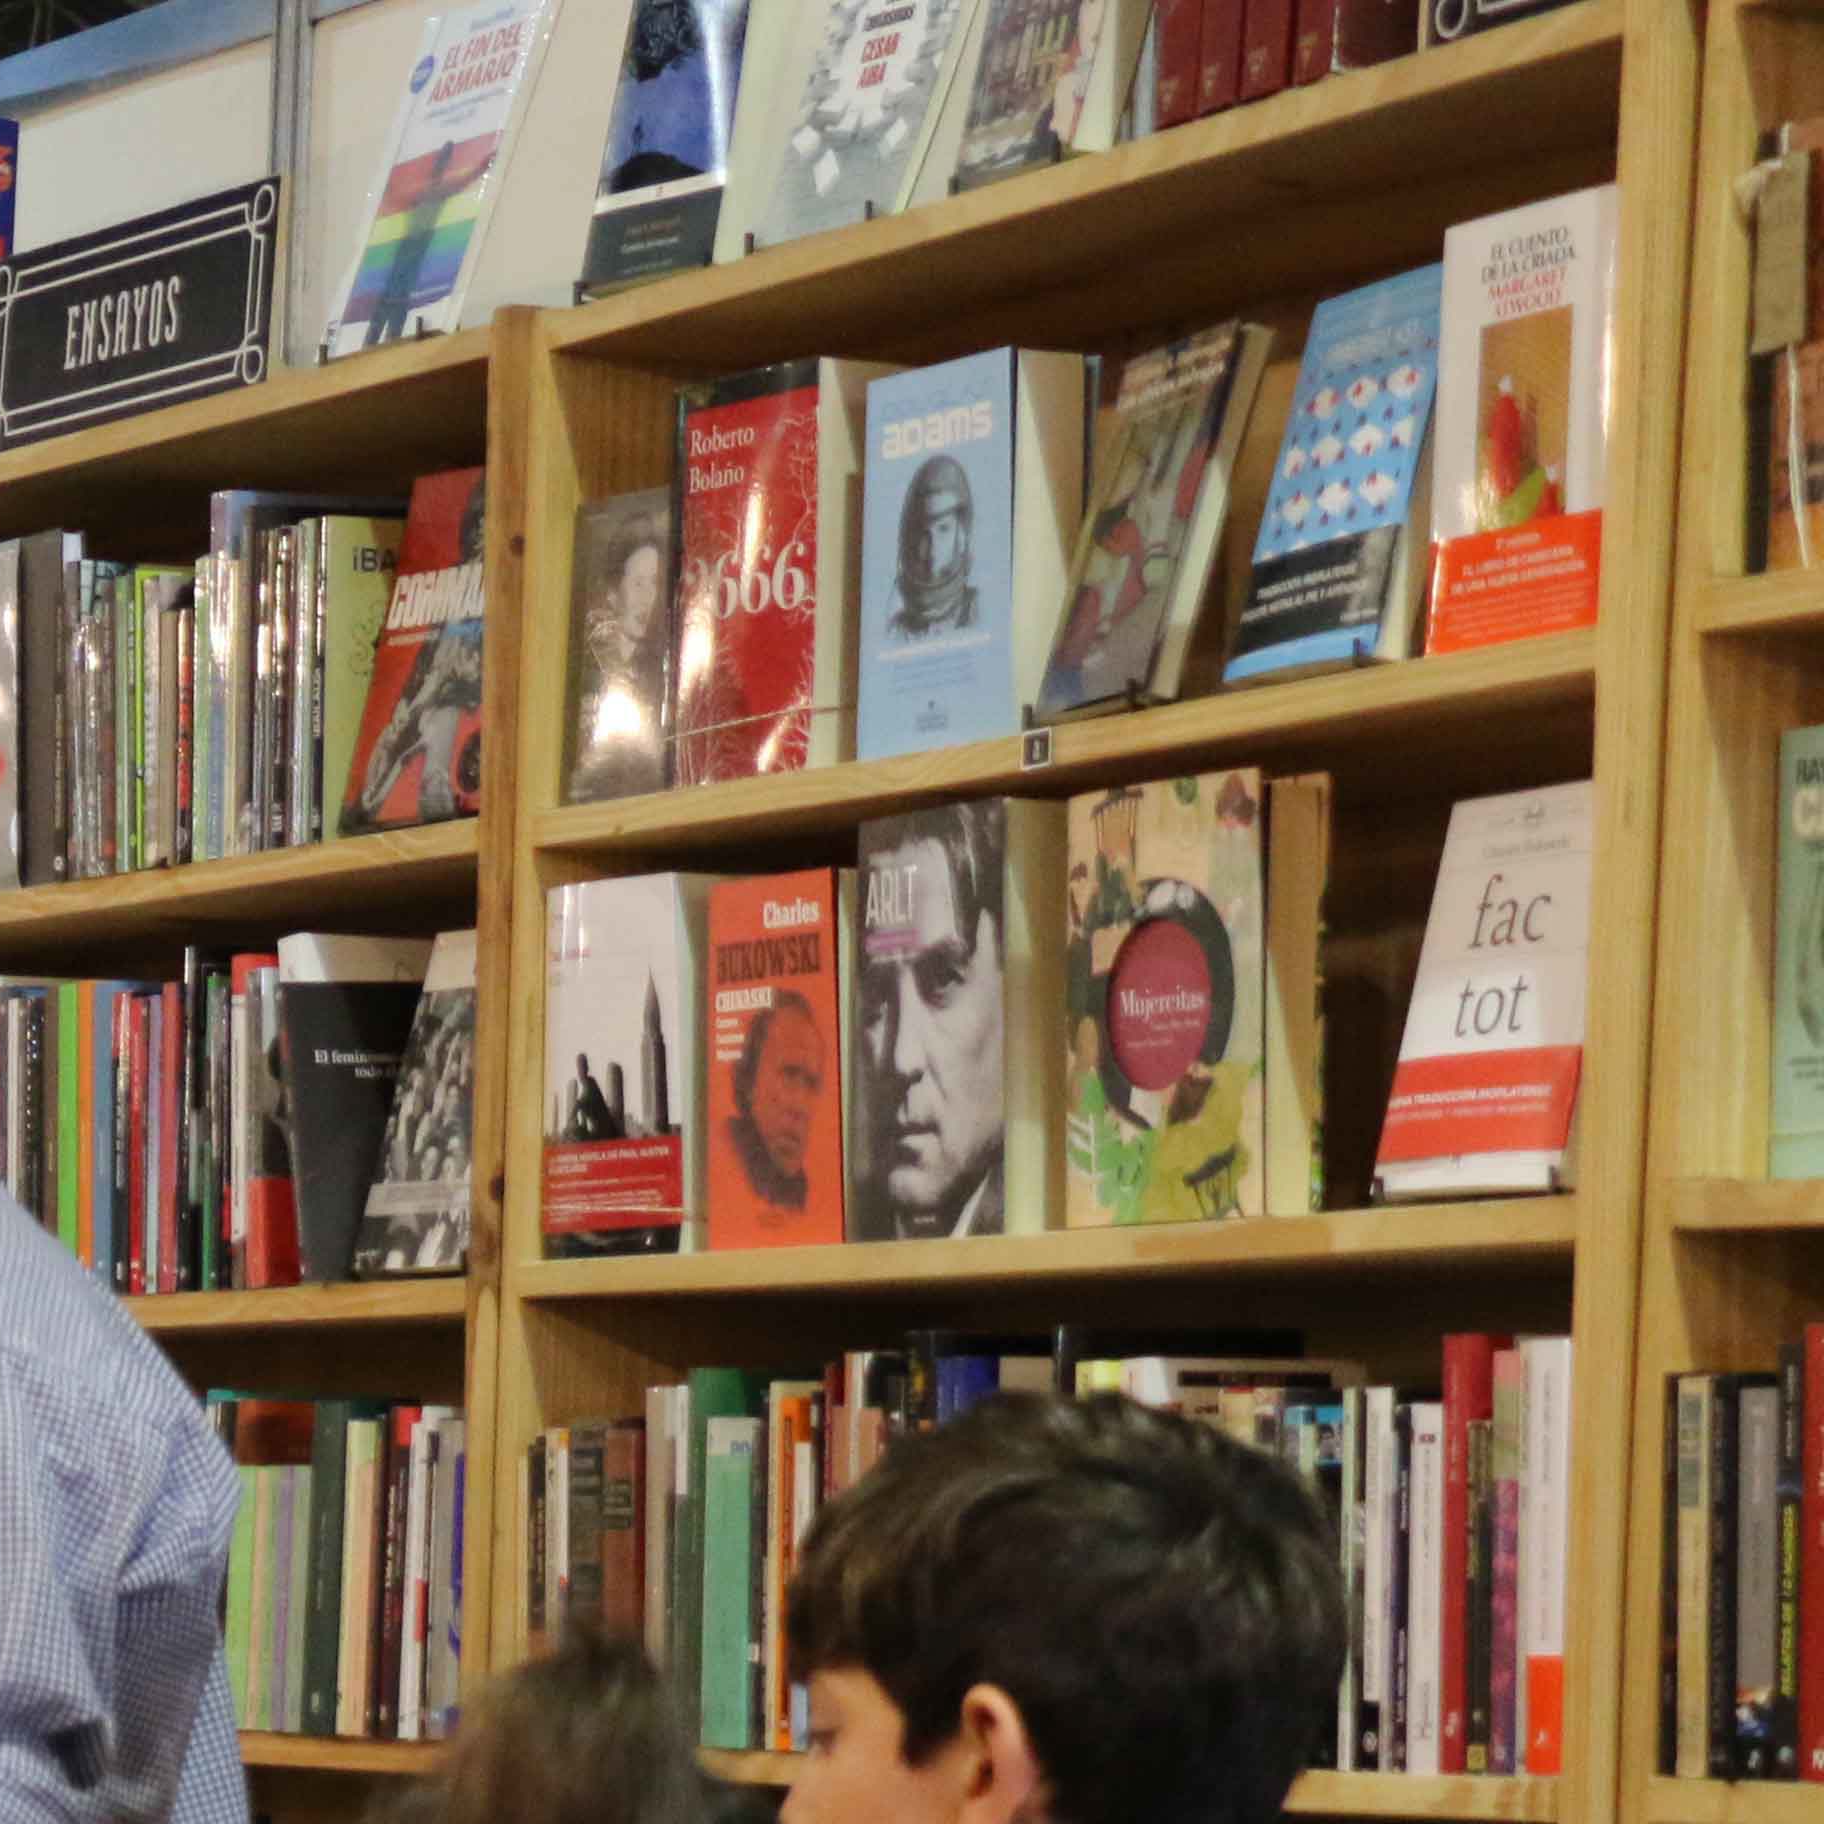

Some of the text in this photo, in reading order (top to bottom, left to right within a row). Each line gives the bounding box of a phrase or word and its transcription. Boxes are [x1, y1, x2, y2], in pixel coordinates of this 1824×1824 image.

[63, 275, 183, 371] ENSAYOS
[688, 424, 756, 456] Roberto
[687, 462, 745, 495] Bolaño
[762, 897, 820, 929] Charles
[864, 863, 918, 927] ARLT
[1467, 873, 1552, 950] fac
[715, 933, 822, 985] BUKOWSKI
[1452, 974, 1529, 1039] tot
